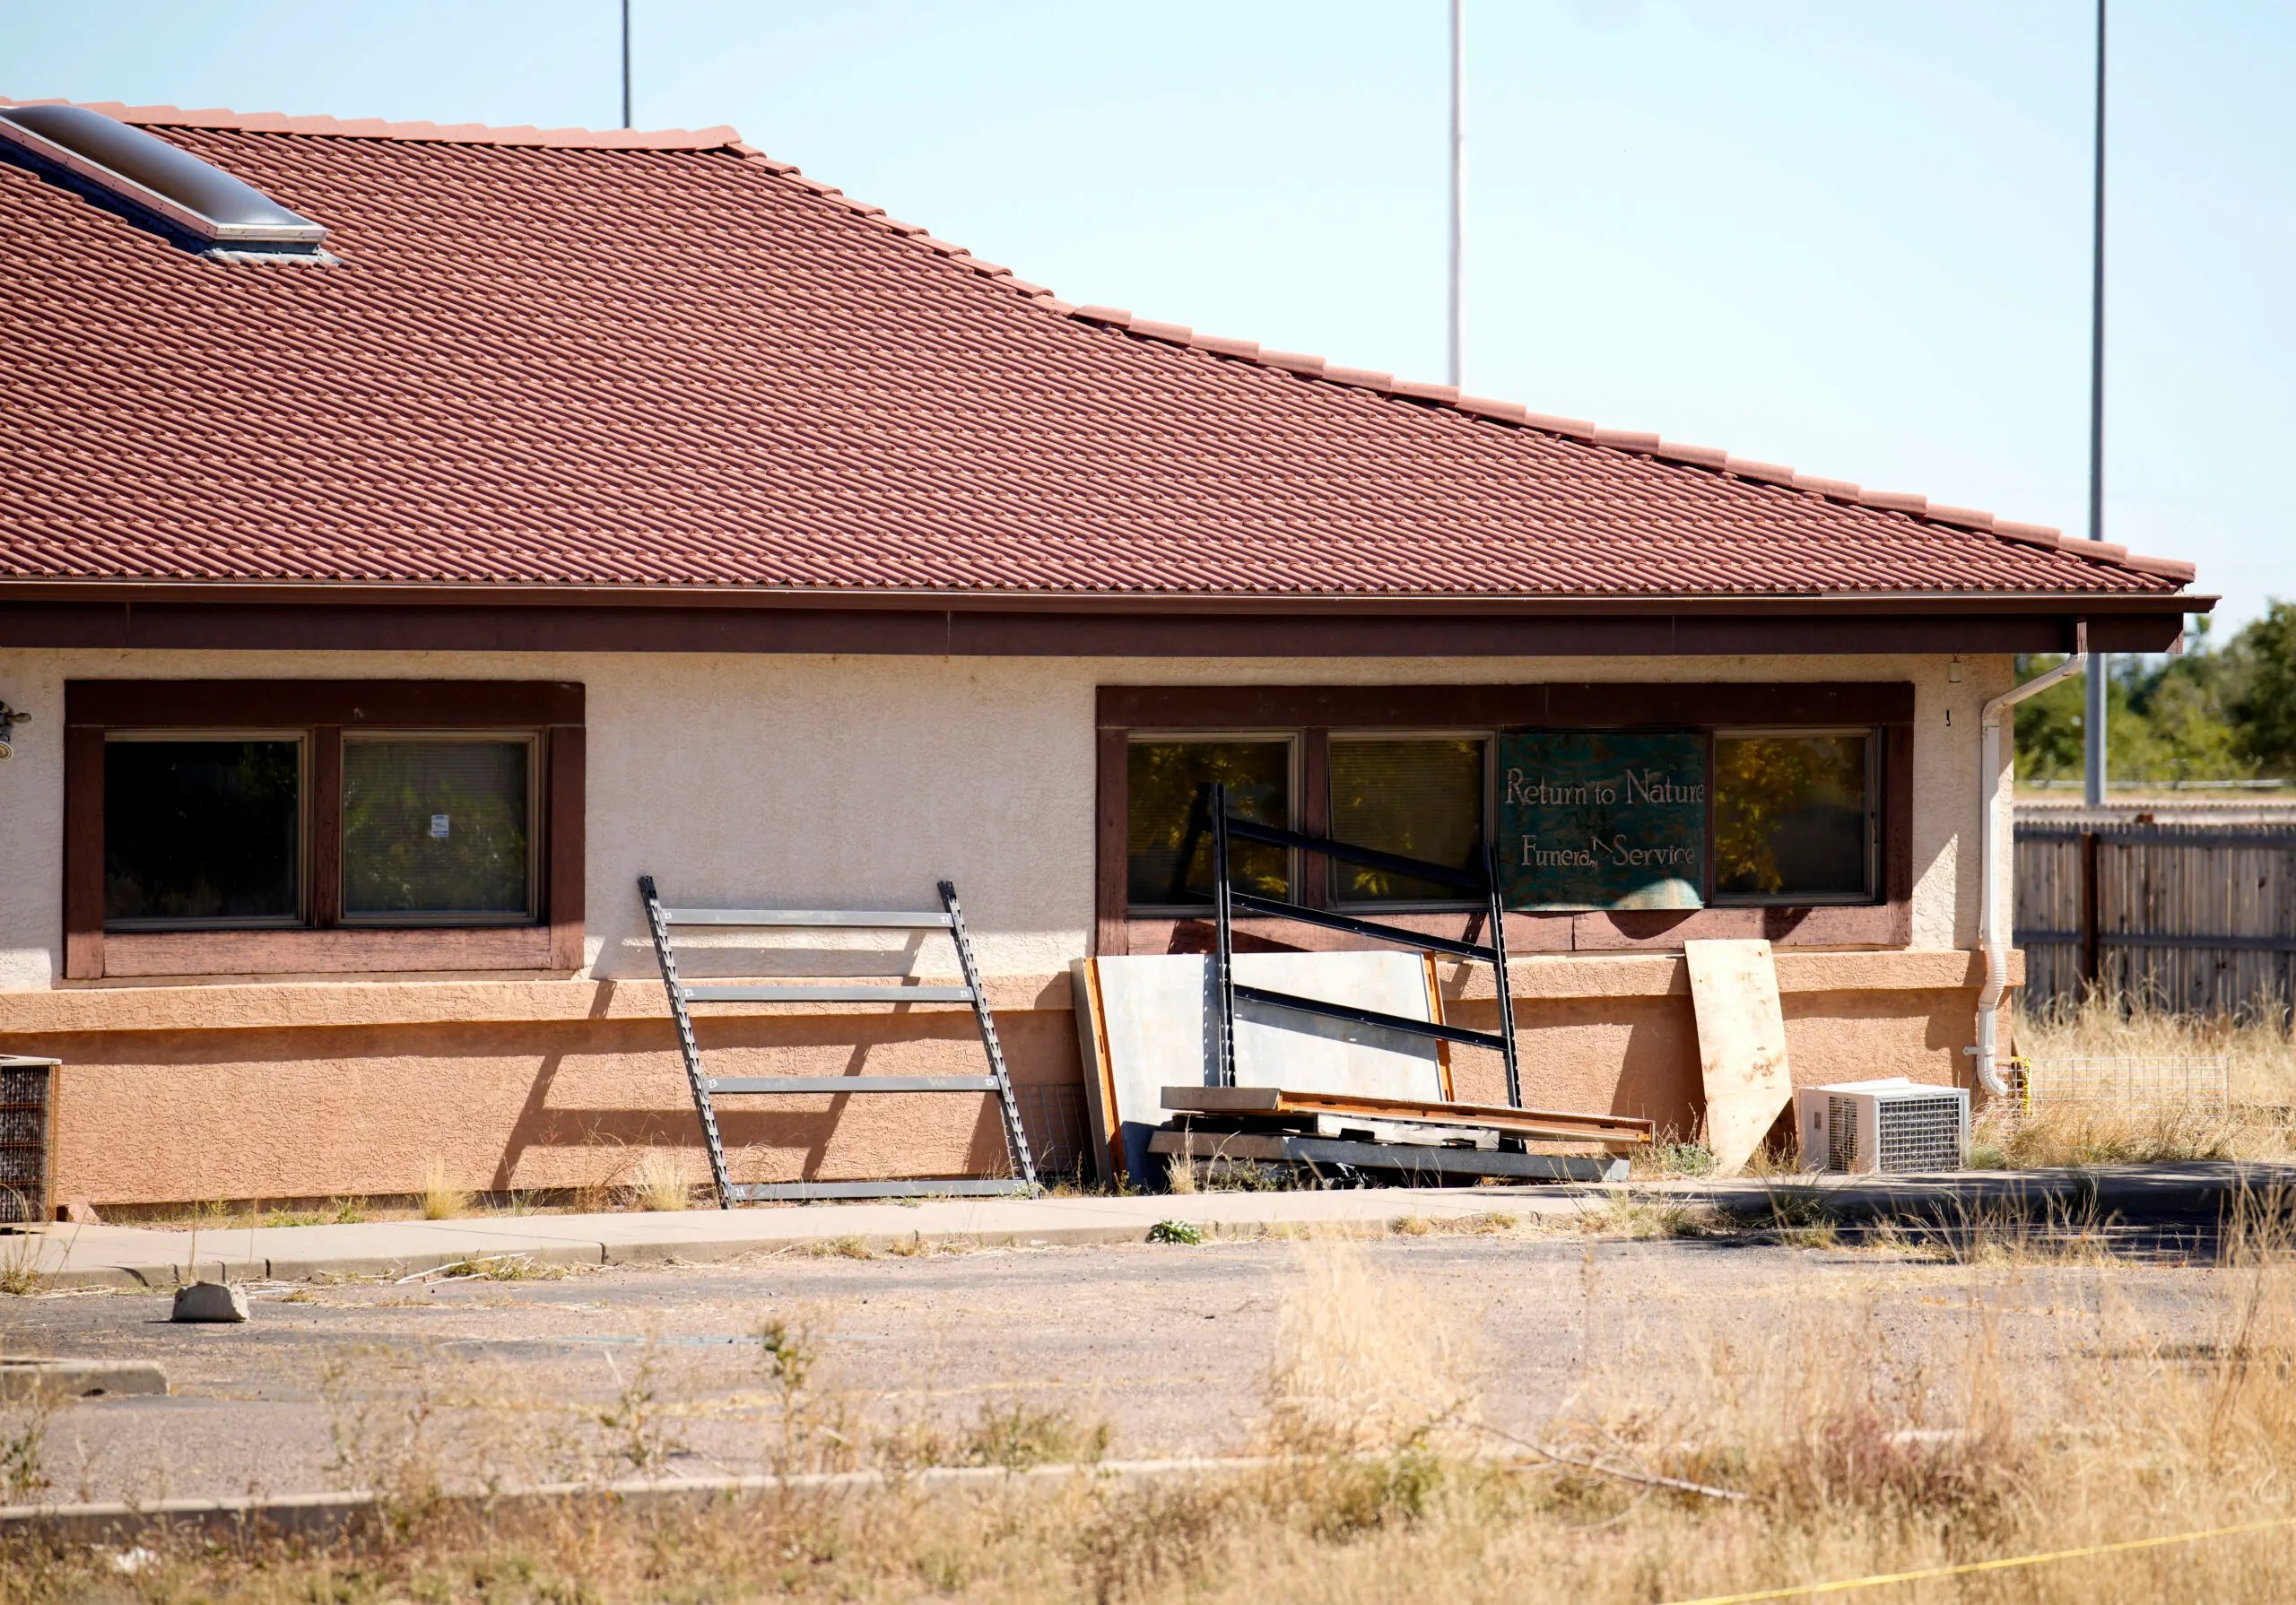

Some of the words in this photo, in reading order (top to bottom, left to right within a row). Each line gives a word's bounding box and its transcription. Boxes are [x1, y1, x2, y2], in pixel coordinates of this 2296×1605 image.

[1505, 768, 1587, 806] Return
[1595, 781, 1617, 805] to
[1624, 768, 1704, 805] Nature
[1612, 834, 1695, 867] Service
